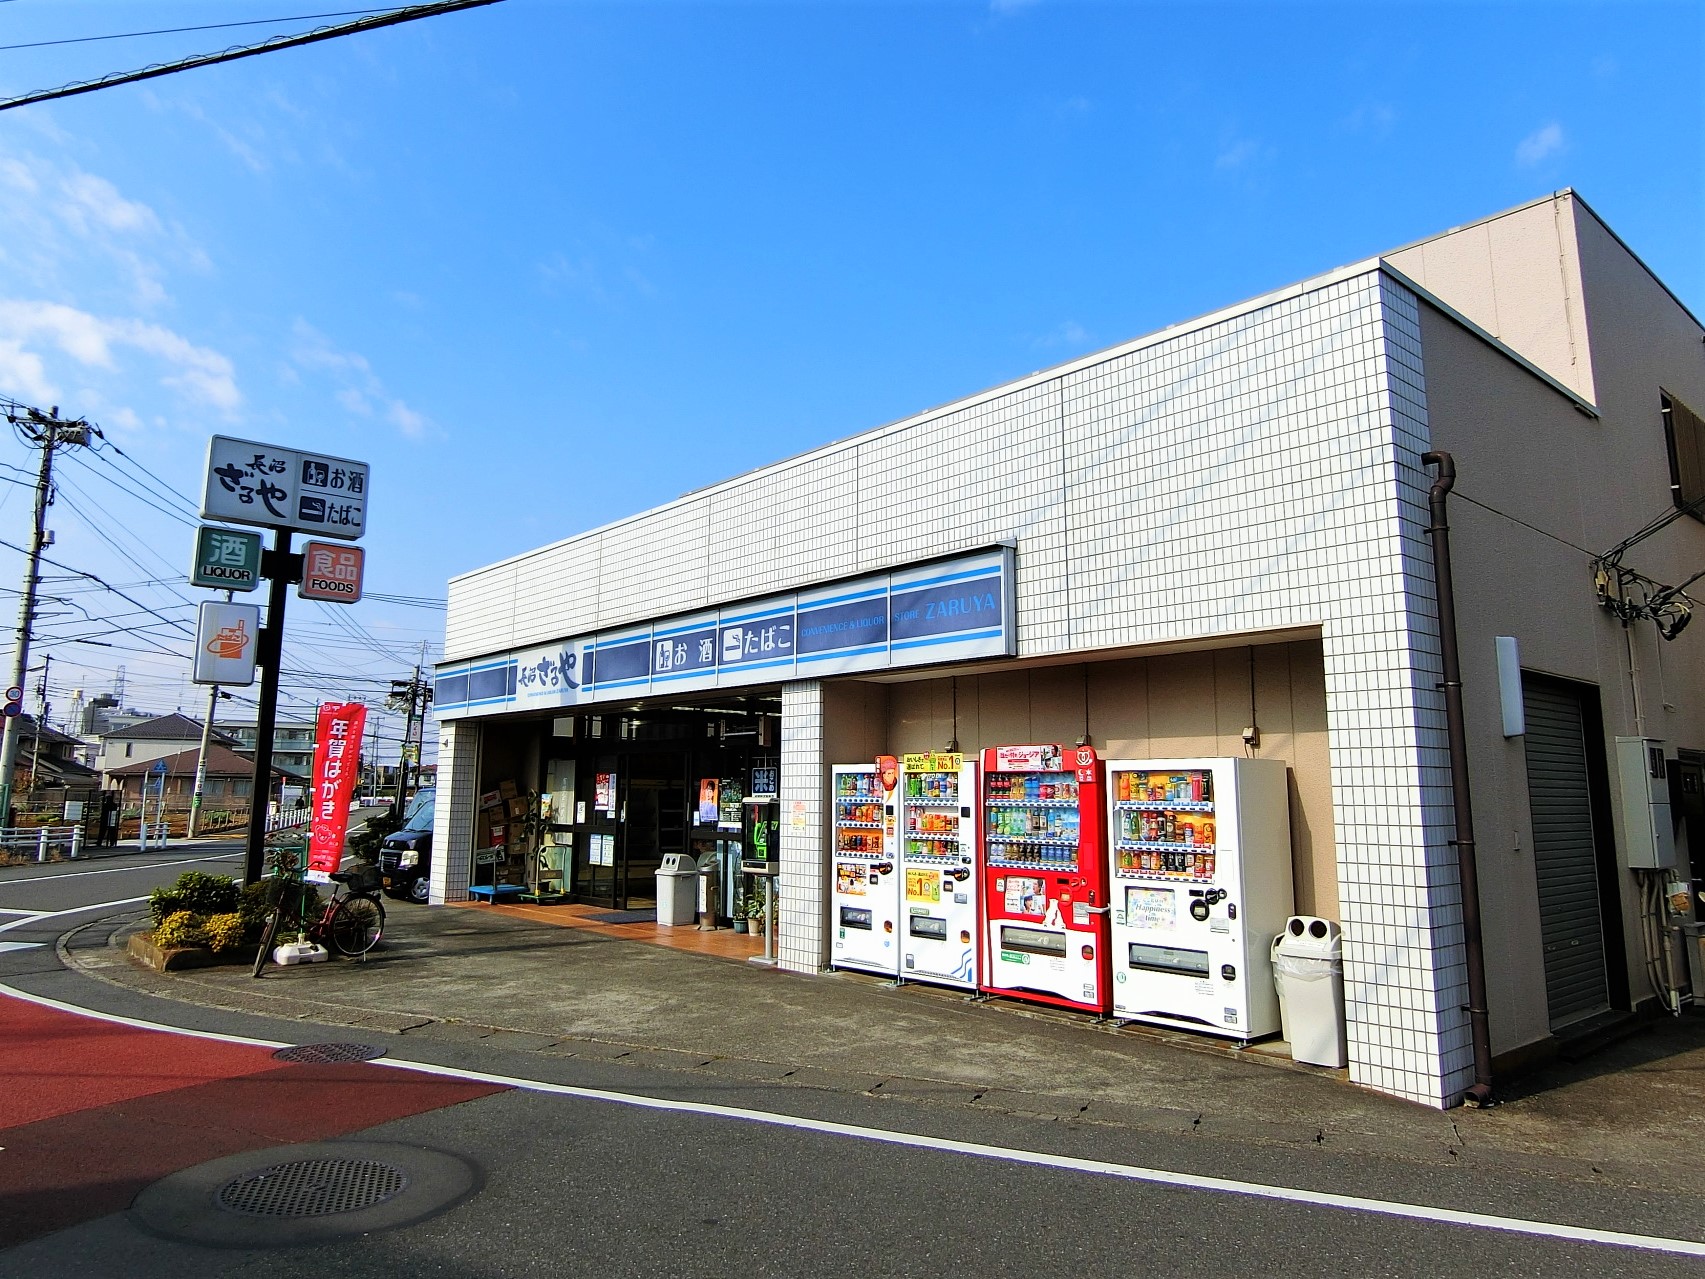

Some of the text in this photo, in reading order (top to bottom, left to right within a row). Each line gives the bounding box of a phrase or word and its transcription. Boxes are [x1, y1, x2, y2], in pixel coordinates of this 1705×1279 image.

[245, 454, 287, 475] 長沼
[213, 463, 288, 518] ざるや
[330, 468, 365, 493] お酒
[326, 502, 362, 527] たばこ
[209, 533, 248, 566] 酒
[203, 565, 251, 581] LIQUOR
[311, 549, 357, 579] 食品
[311, 579, 354, 593] FOODS
[801, 592, 996, 637] CONVENIENCE & LIQUOR STORE ZARUYA
[744, 625, 791, 654] たばこ
[321, 718, 349, 820] 年賀はがき
[937, 755, 954, 770] No.1
[754, 770, 769, 792] 米
[1135, 903, 1171, 914] Happiness
